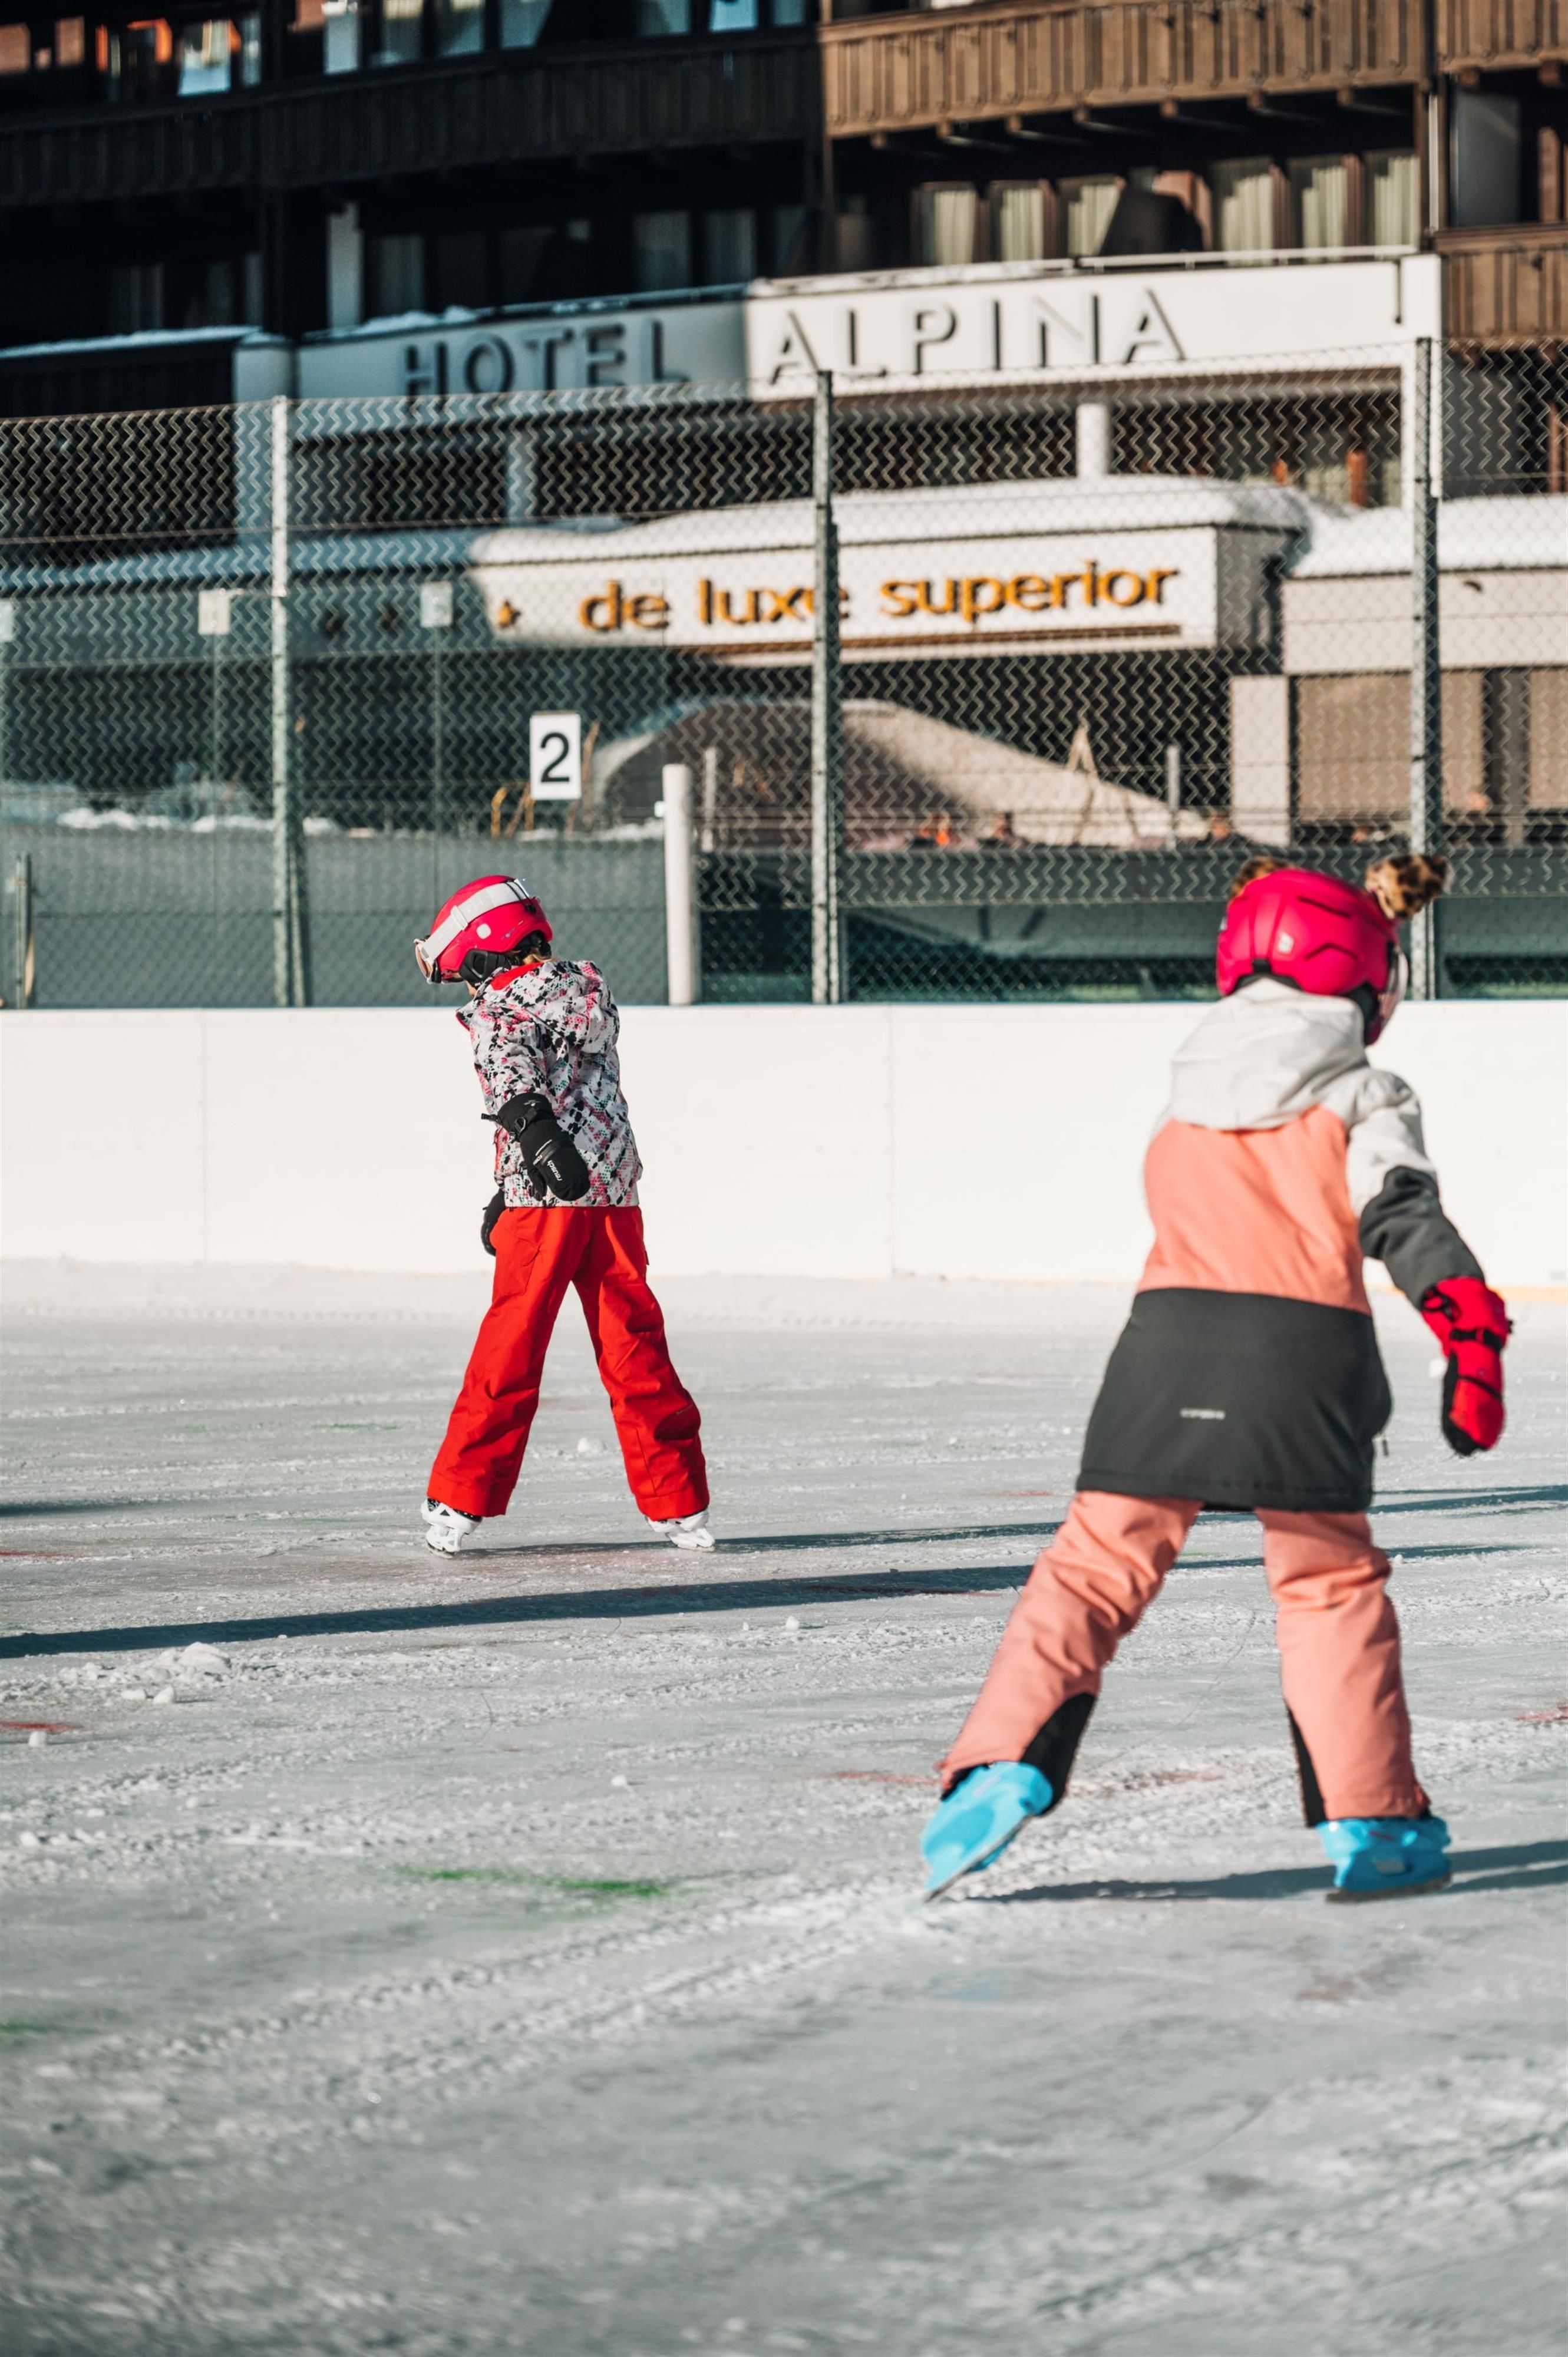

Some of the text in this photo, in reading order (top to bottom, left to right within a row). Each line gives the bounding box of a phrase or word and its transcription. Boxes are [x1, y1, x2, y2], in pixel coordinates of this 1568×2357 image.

[402, 286, 1187, 405] HOTEL ALPINA
[579, 579, 669, 631] de
[880, 559, 1181, 629] superior
[540, 732, 570, 783] 2
[546, 1160, 563, 1181] reusch
